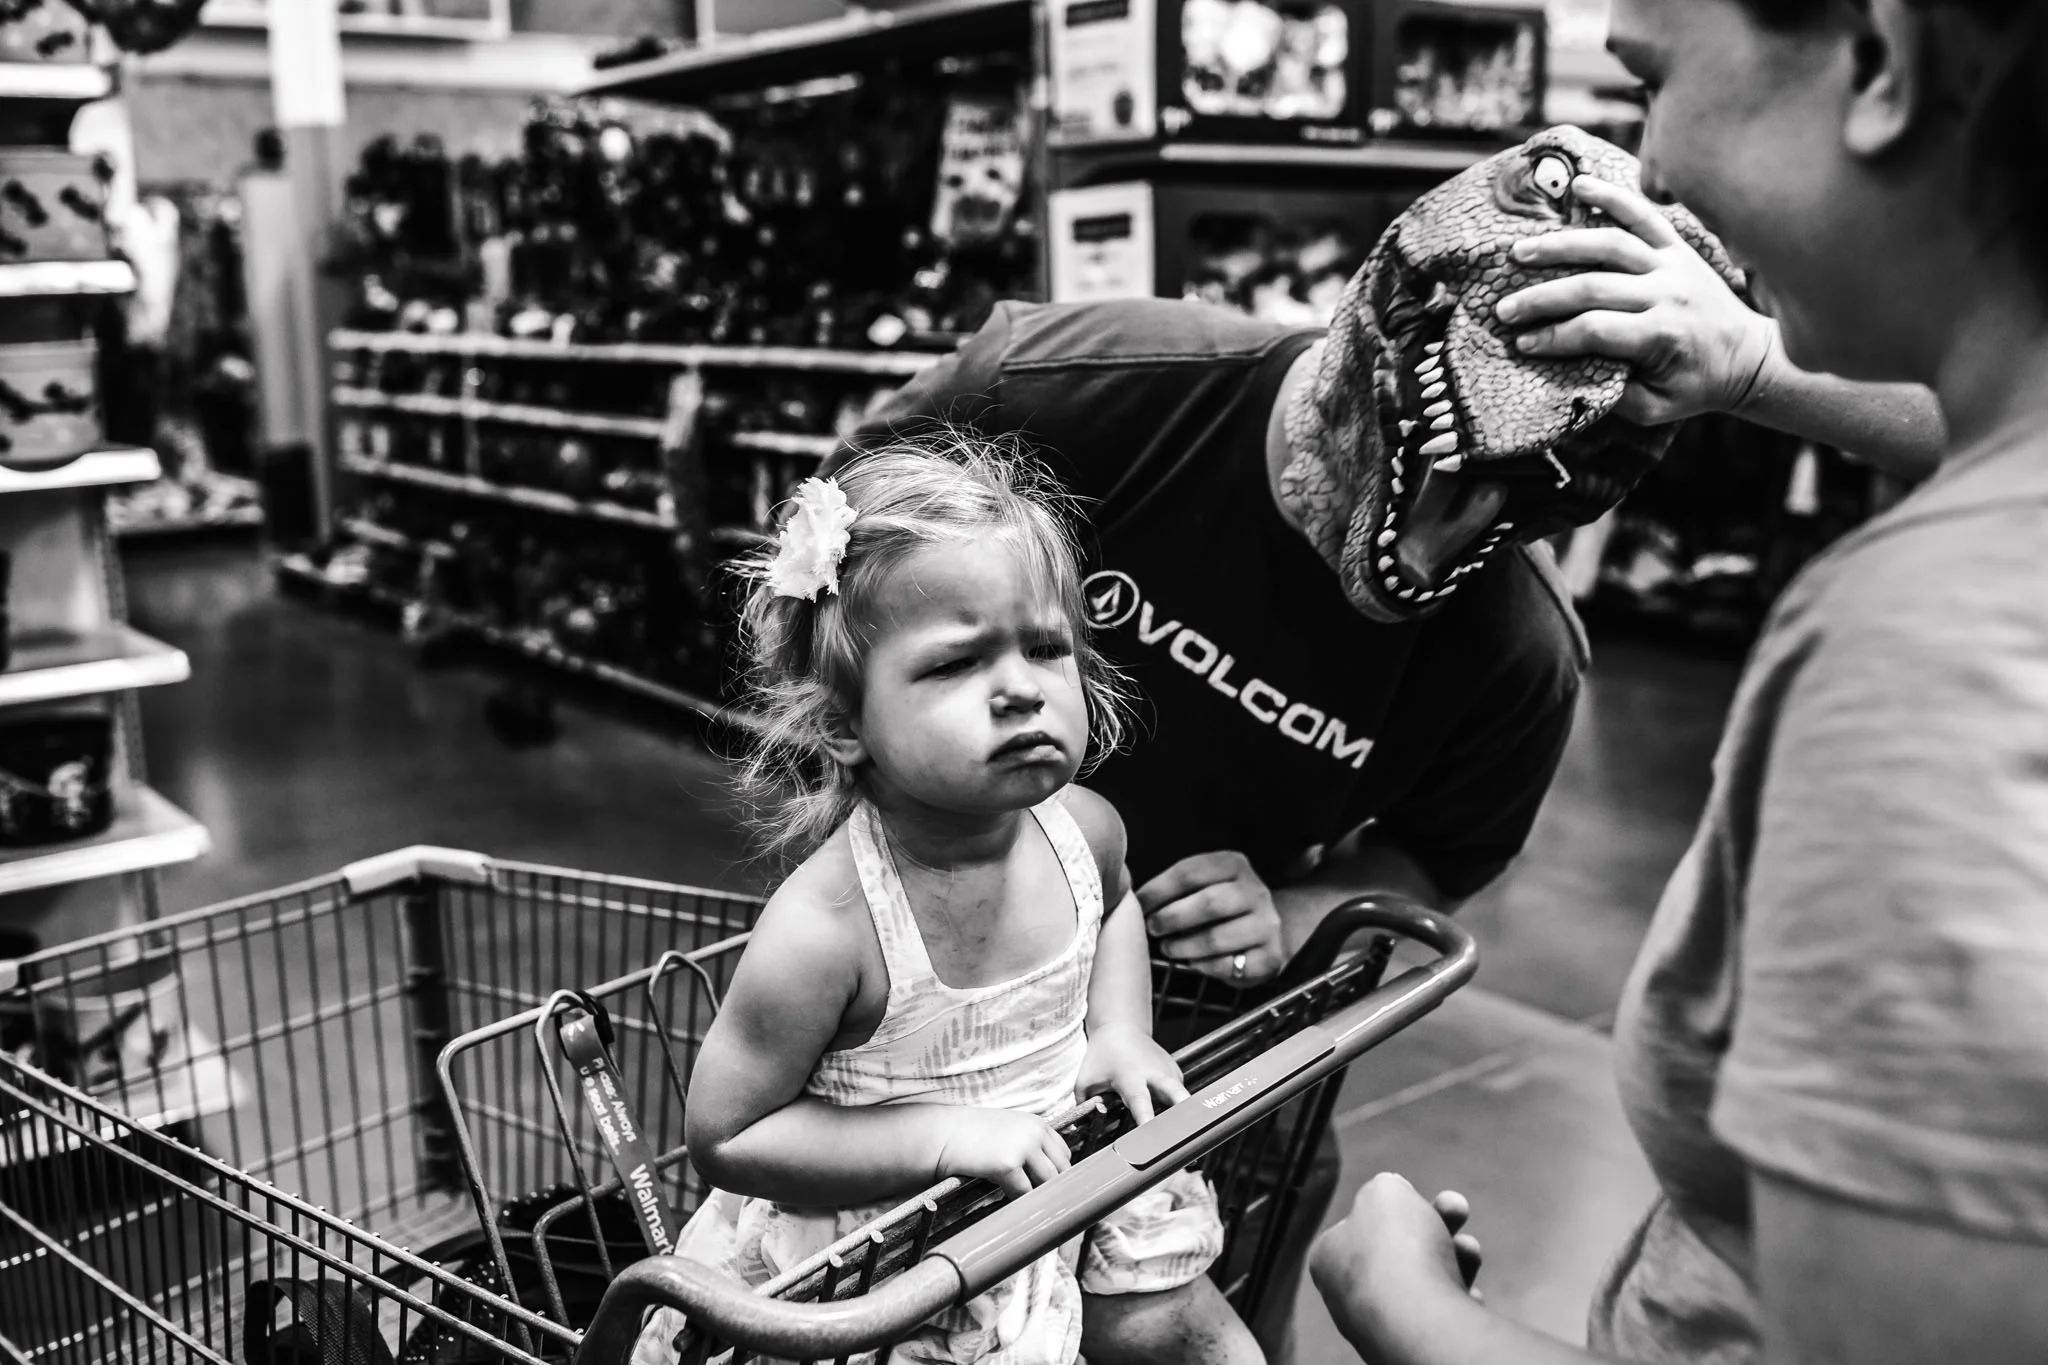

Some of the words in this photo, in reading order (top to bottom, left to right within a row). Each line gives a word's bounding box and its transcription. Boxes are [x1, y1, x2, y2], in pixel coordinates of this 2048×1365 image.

[1138, 600, 1375, 769] VOLCOM
[611, 1101, 637, 1142] Always
[630, 1163, 675, 1256] Walmart
